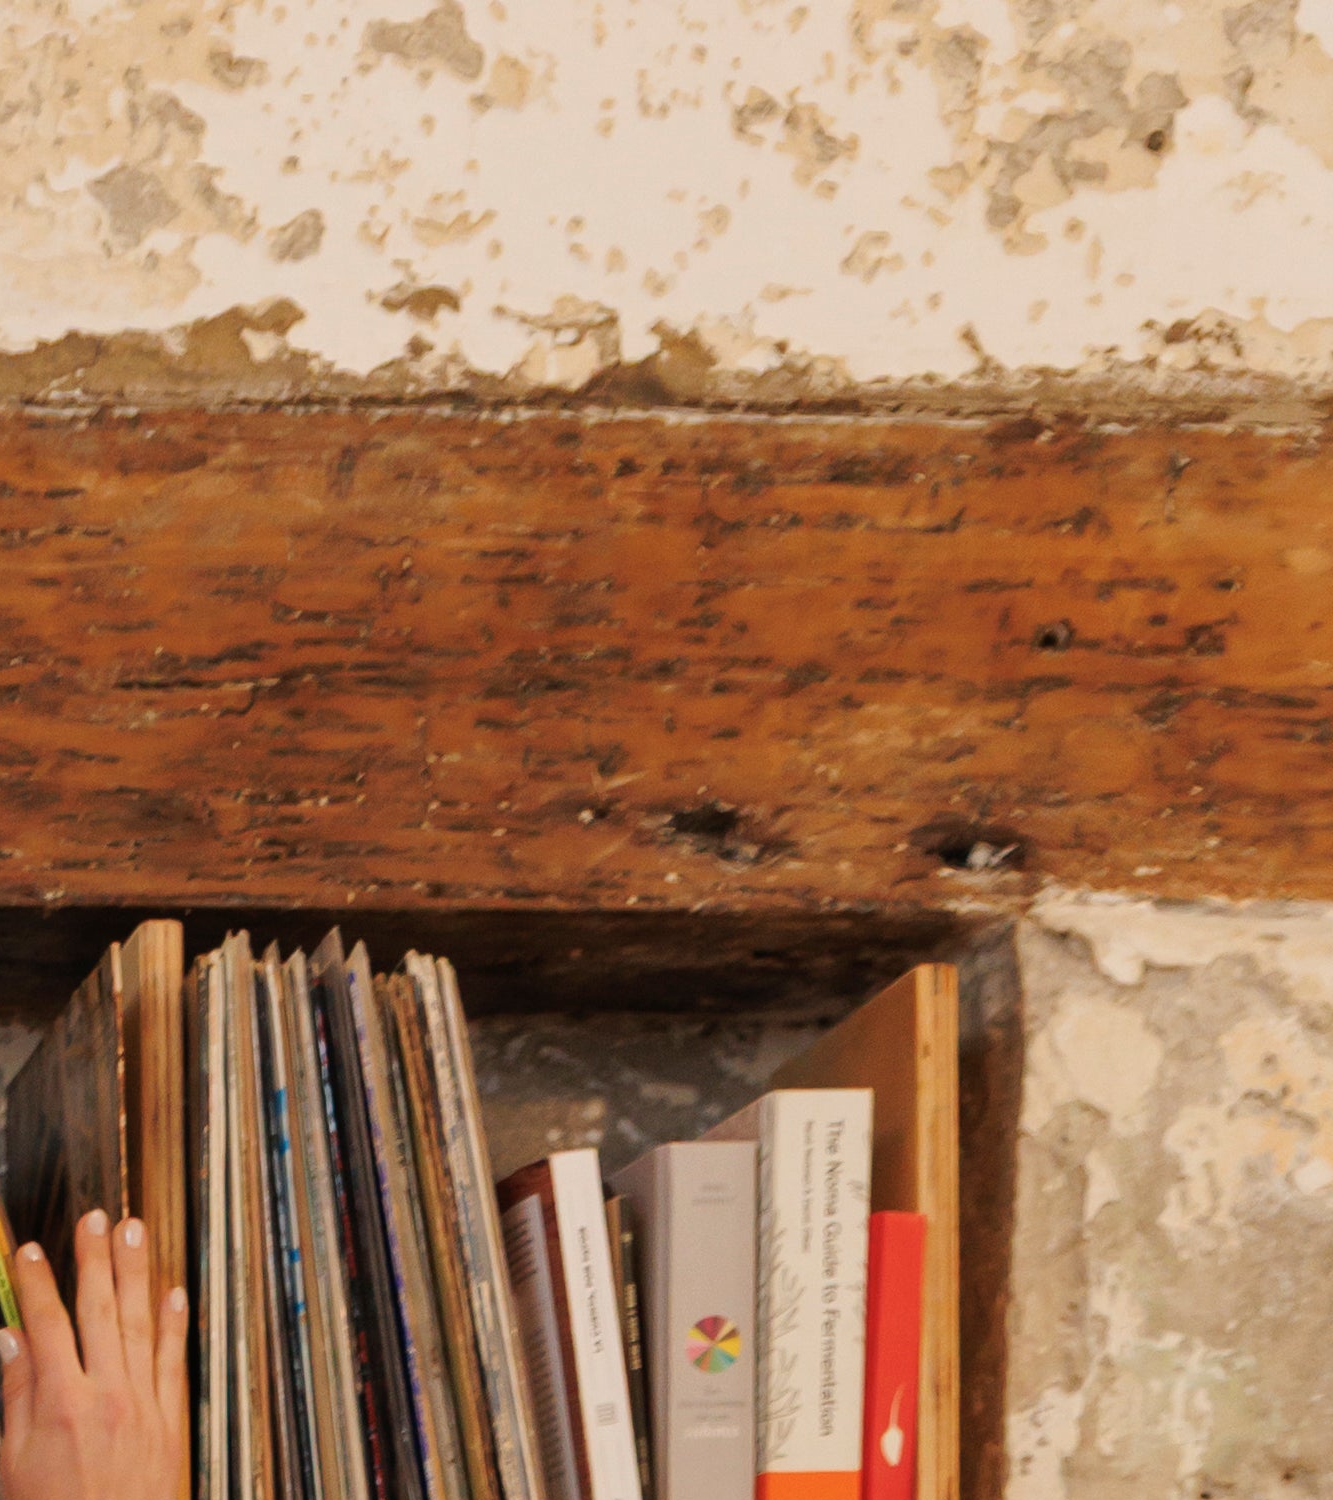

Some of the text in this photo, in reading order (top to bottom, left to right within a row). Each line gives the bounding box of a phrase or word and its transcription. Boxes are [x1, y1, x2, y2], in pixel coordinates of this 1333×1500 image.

[818, 1120, 845, 1438] The Noma Guide to Fermentation
